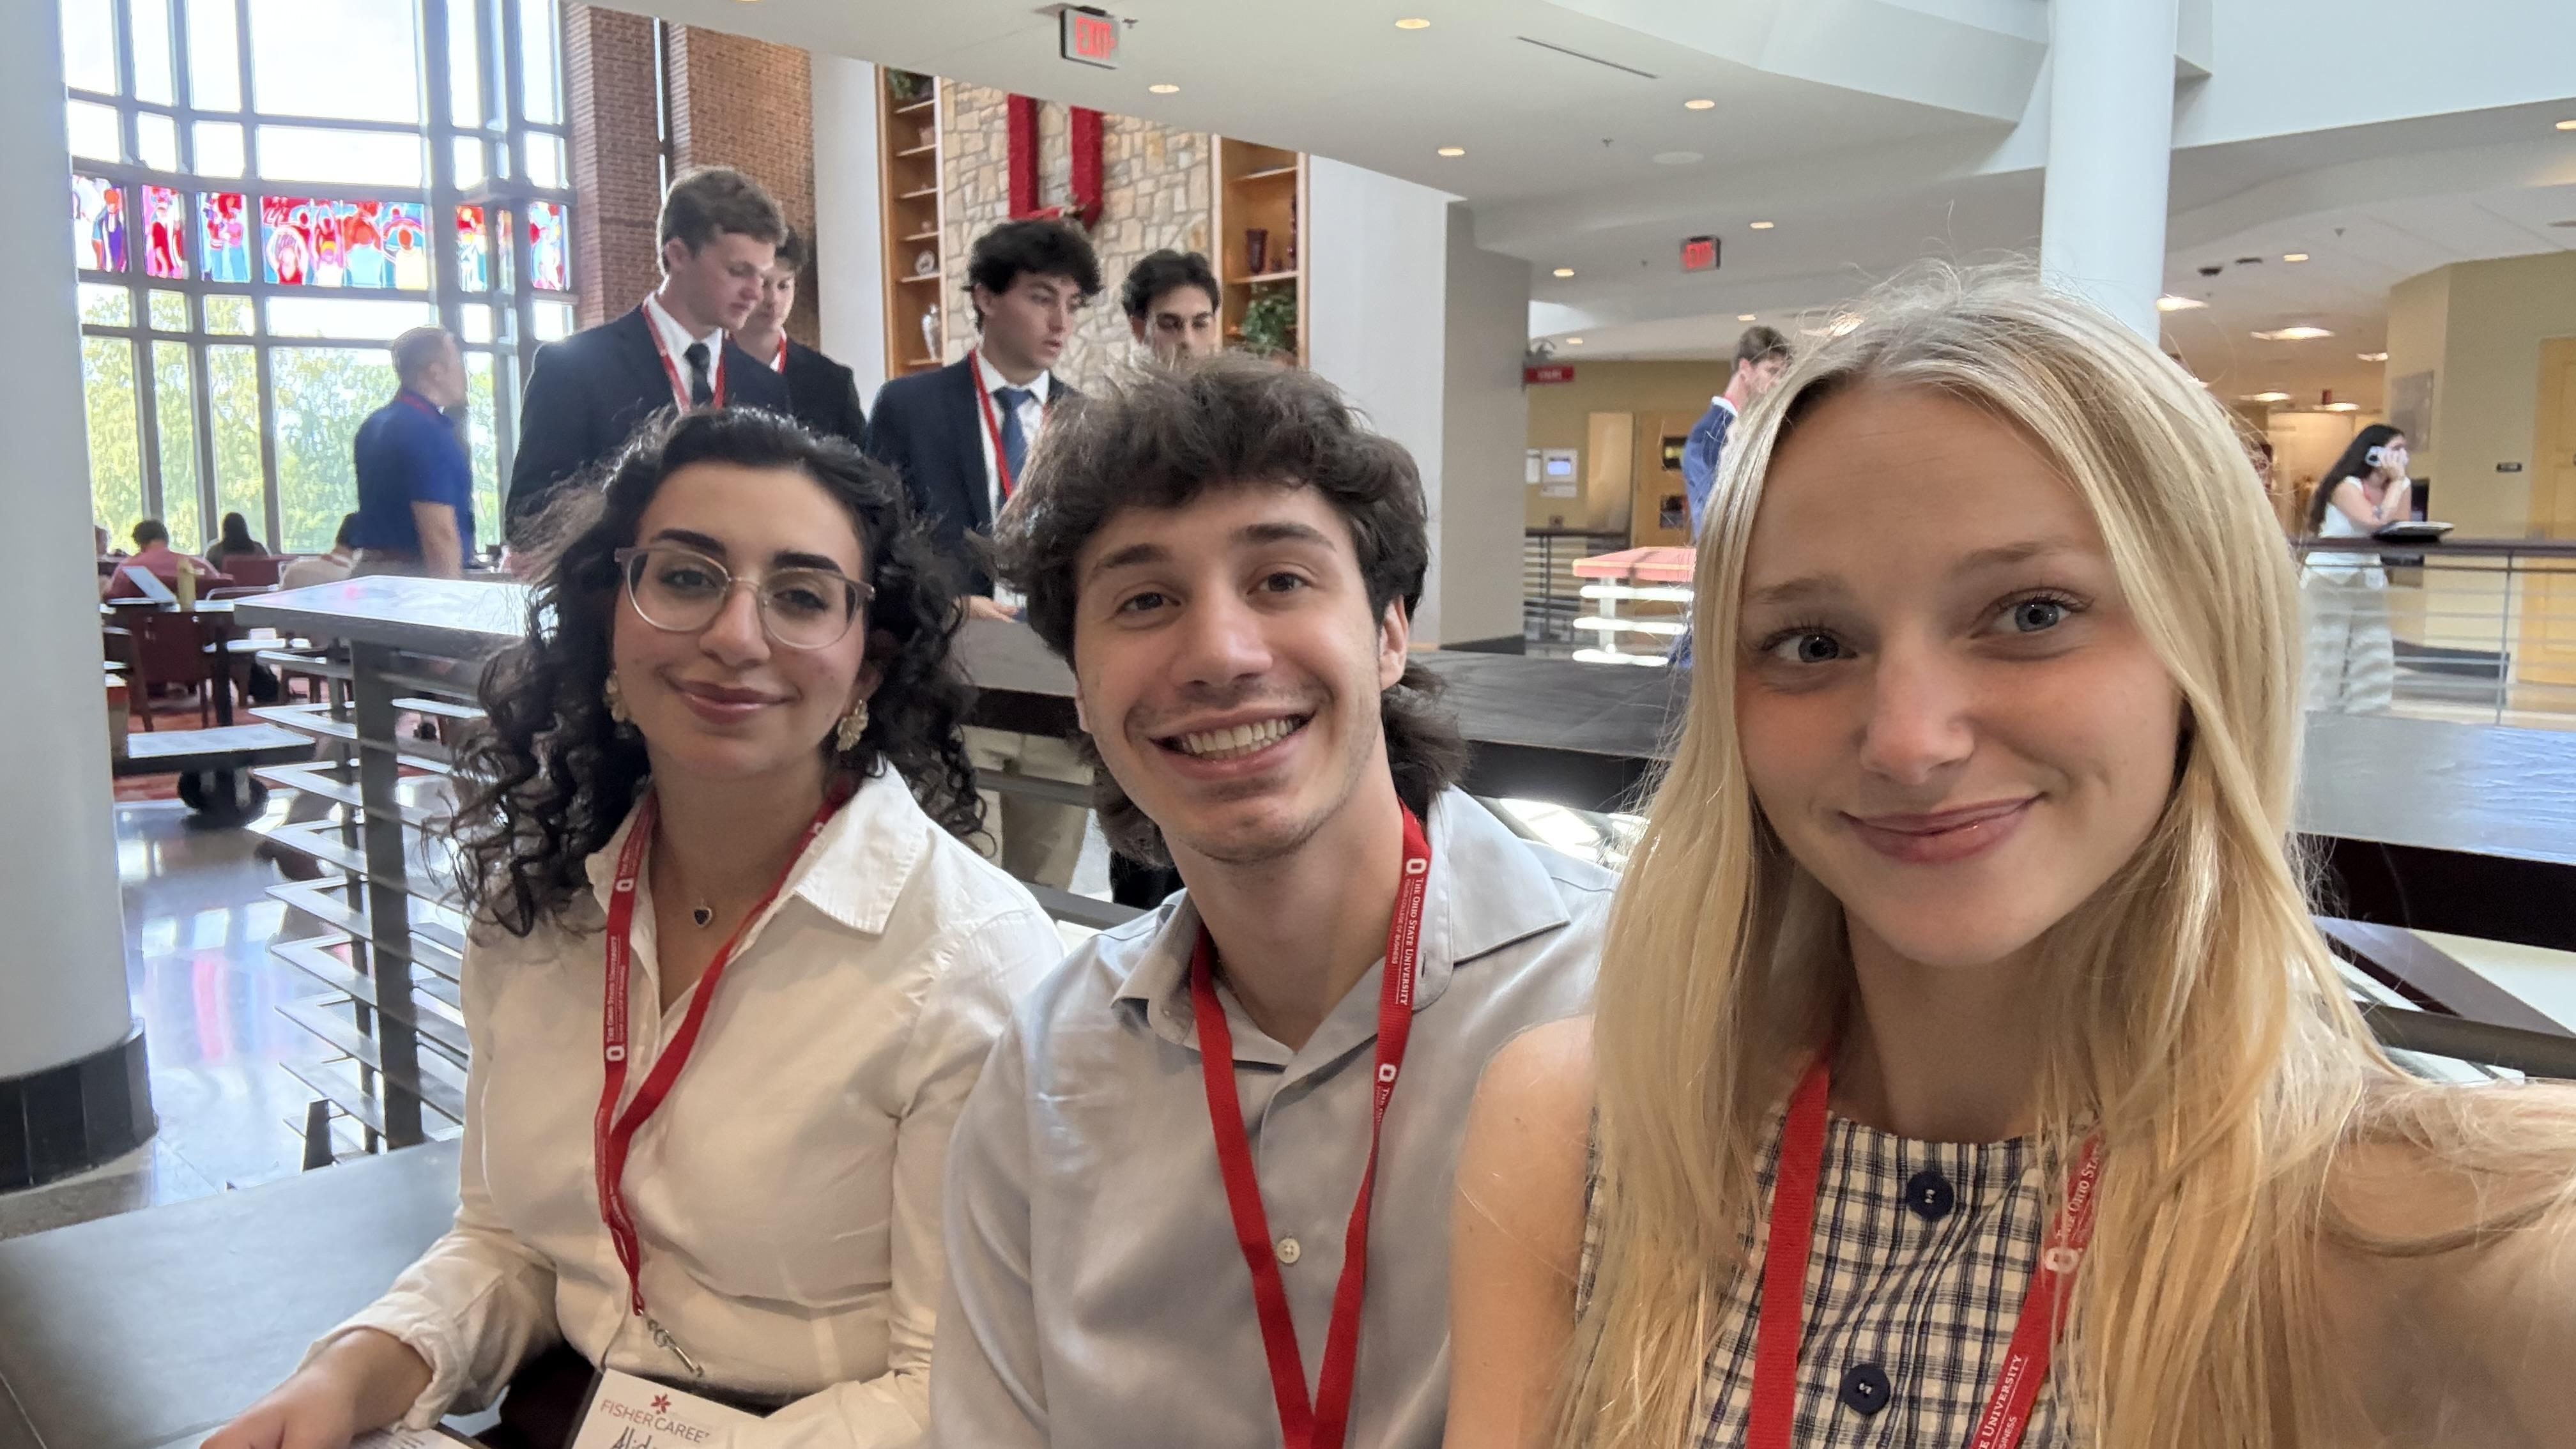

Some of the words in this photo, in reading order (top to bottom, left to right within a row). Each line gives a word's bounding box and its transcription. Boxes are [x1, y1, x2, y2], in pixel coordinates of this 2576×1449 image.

[1413, 878, 1424, 894] THE
[1410, 896, 1421, 917] OHIO
[1406, 919, 1418, 946] STATE
[1400, 949, 1414, 1006] UNIVERSITY
[2067, 1180, 2090, 1211] OHIO
[1982, 1354, 2022, 1437] UNIVERSITY
[599, 1399, 654, 1428] FISHER
[654, 1417, 710, 1444] CAREE
[1998, 1416, 2018, 1449] SINESS
